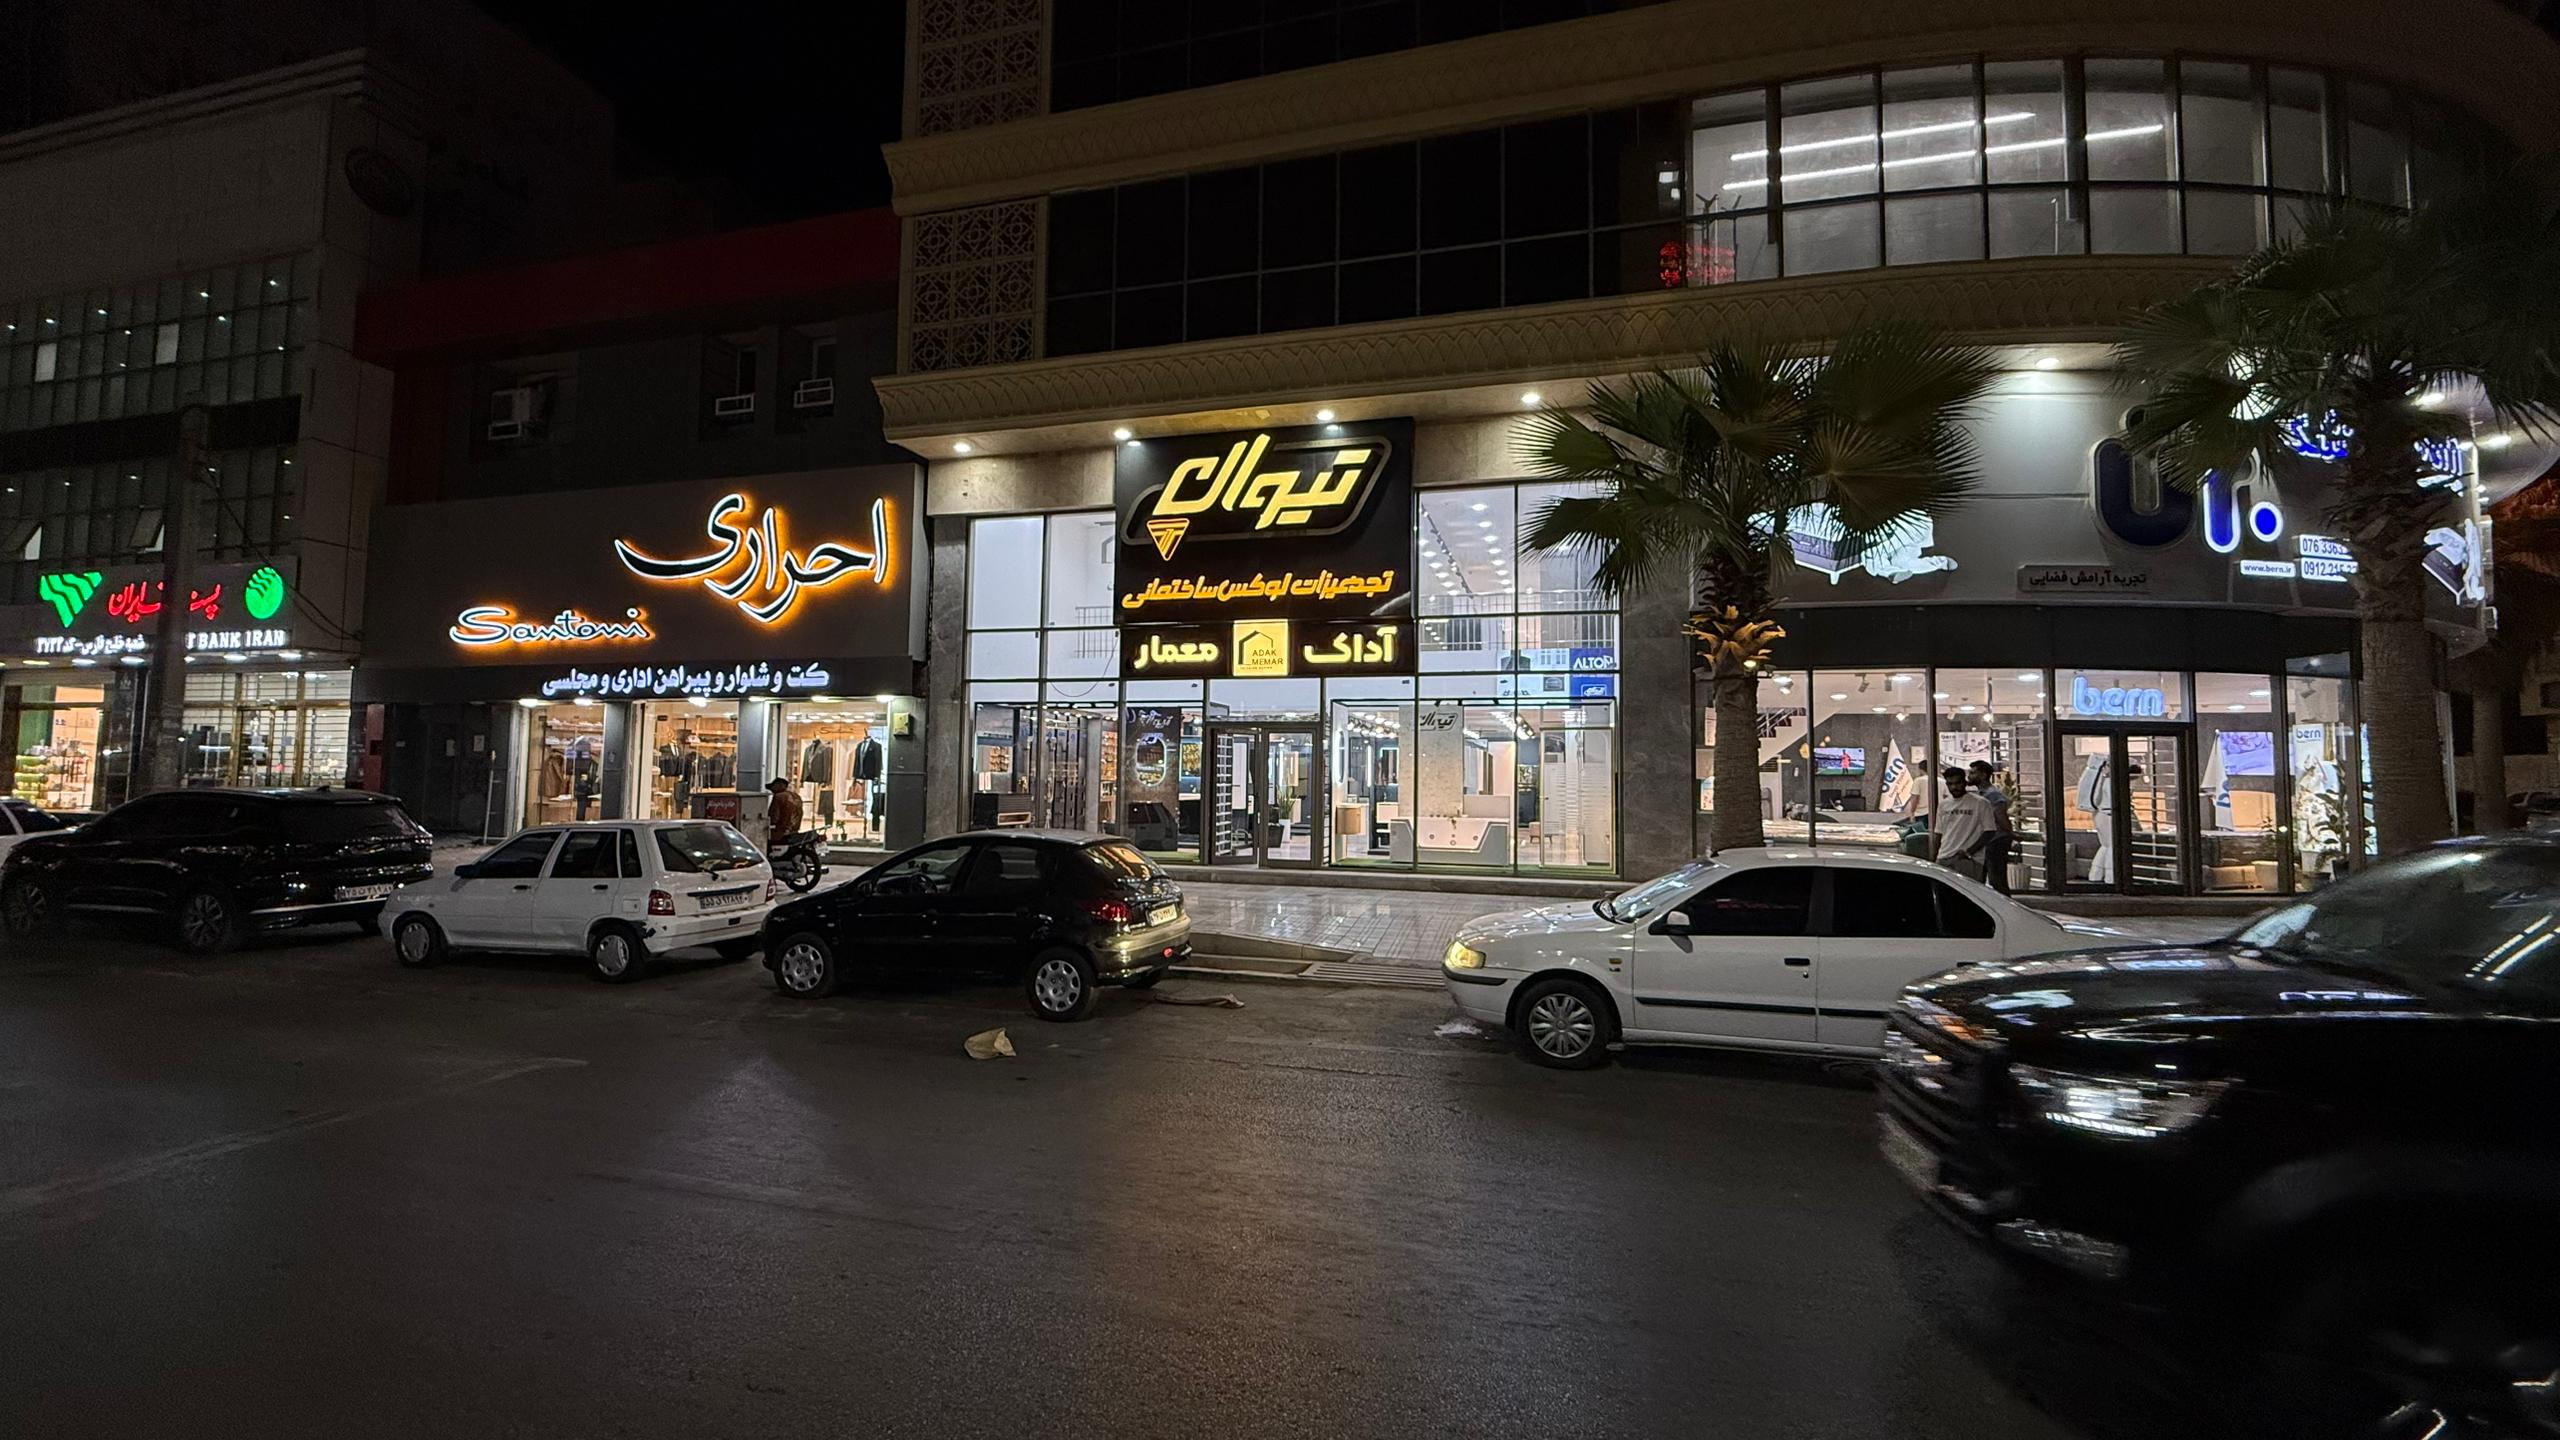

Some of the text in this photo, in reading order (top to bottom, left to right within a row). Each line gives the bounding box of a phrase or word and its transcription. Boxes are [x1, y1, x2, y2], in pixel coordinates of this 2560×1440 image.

[1151, 433, 1372, 530] تیوال
[2302, 538, 2319, 552] 076
[613, 493, 888, 622] احراری
[2243, 563, 2292, 574] www.bern.ir
[2304, 561, 2326, 576] 0912
[2028, 569, 2147, 587] تجربه آرامش فضایی
[1122, 570, 1395, 609] تجهیزات لوکس ساختمانی
[449, 606, 649, 645] Santoni
[197, 631, 242, 650] BANK
[244, 628, 285, 648] IRAN
[1133, 626, 1399, 670] آداک معمار
[1251, 658, 1284, 666] MEMAR
[1252, 649, 1277, 657] ADAK
[542, 662, 829, 697] کت و شلوار و پیراهن اداری و مجلسی
[2073, 676, 2164, 717] bern
[2296, 727, 2321, 738] bern
